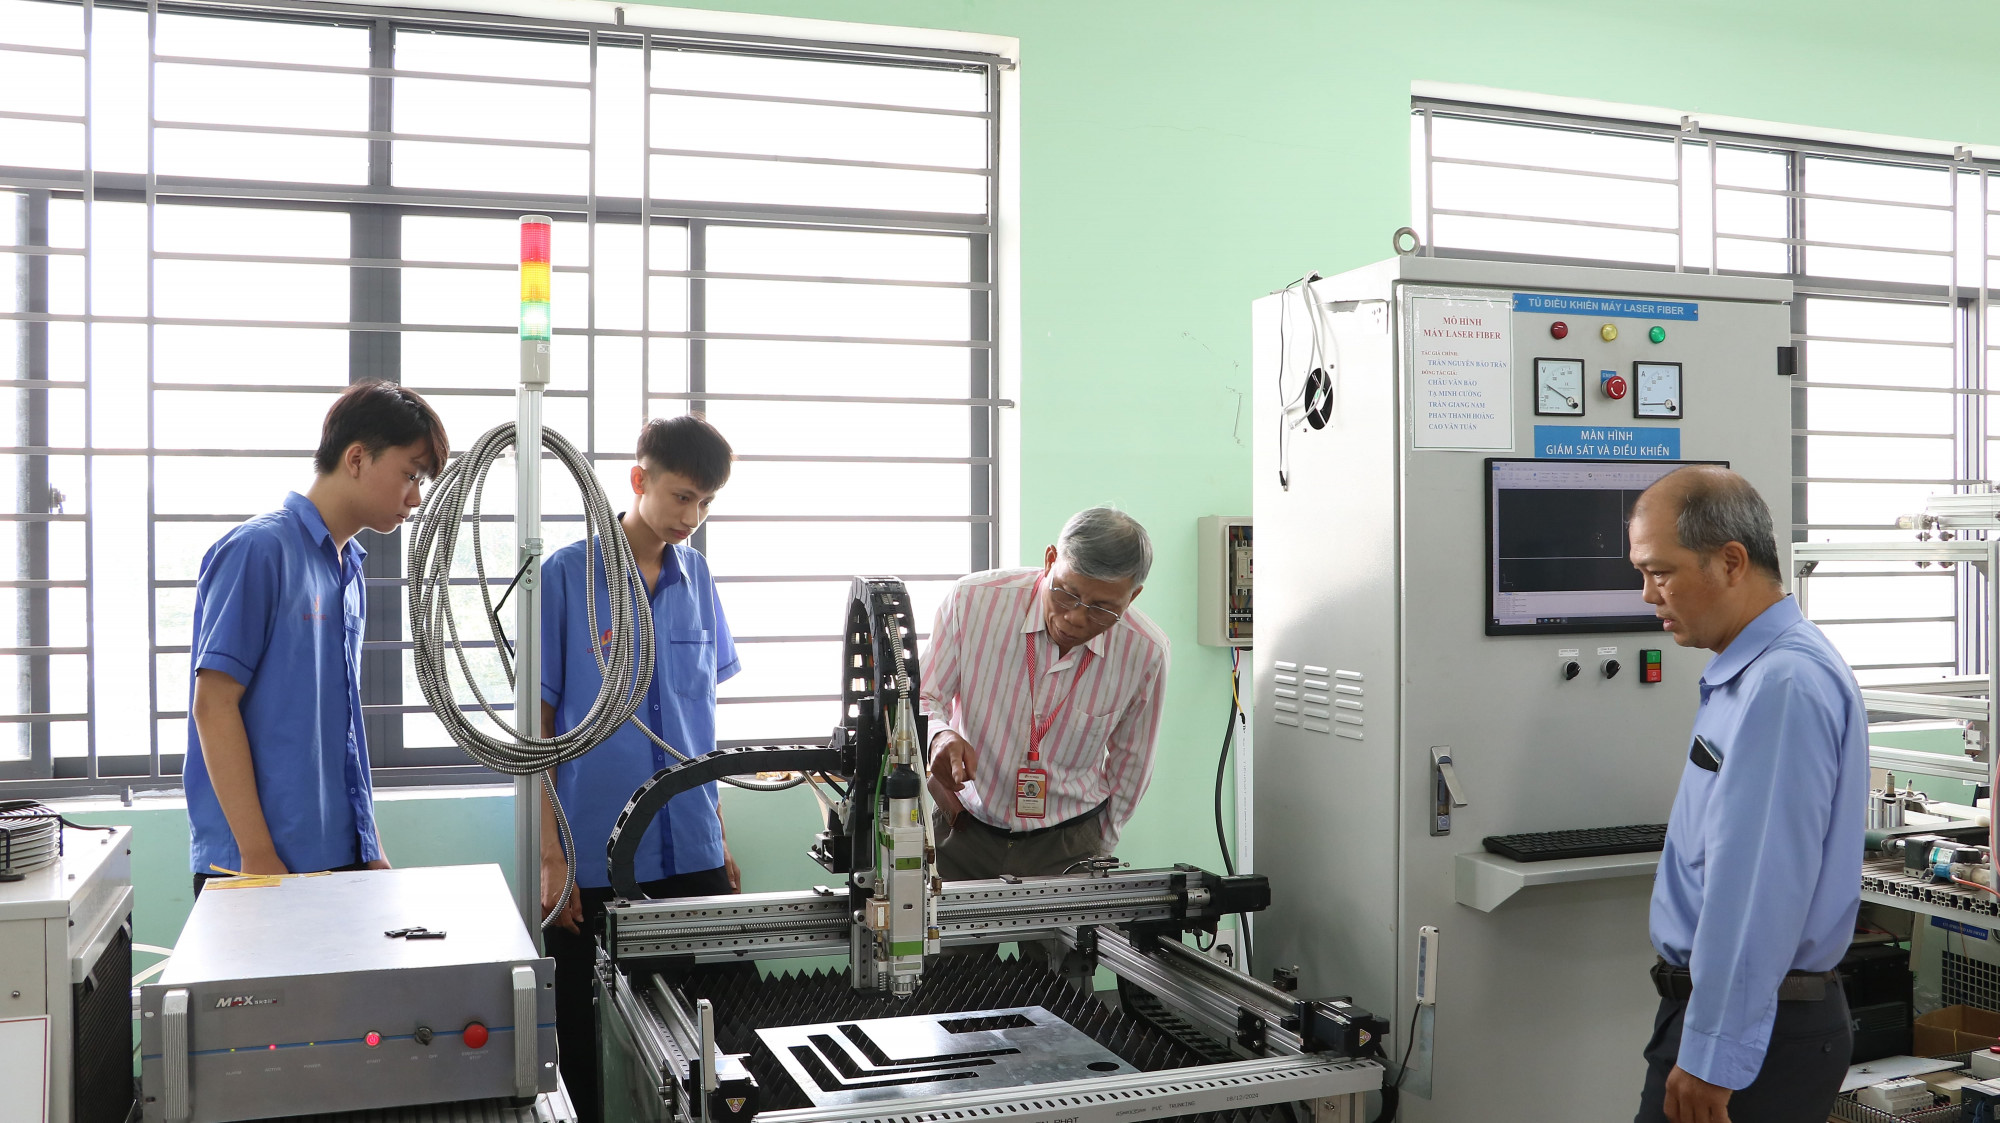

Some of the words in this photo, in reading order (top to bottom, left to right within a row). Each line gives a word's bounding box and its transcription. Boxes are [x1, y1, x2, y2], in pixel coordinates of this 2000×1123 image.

[1601, 300, 1622, 312] MÁY
[1624, 302, 1655, 314] LASER
[1657, 305, 1684, 315] FIBER
[1443, 315, 1458, 325] MÔ
[1460, 316, 1482, 326] HÌNH
[1423, 327, 1444, 337] MÁY
[1446, 330, 1474, 338] LASER
[1476, 331, 1501, 340] FIBER
[1581, 429, 1604, 441] MÀN
[1607, 429, 1633, 441] HÌNH
[1545, 443, 1573, 455] GIÁM
[1576, 443, 1594, 455] SÁT
[1597, 444, 1610, 455] VÀ
[215, 995, 254, 1008] MAX
